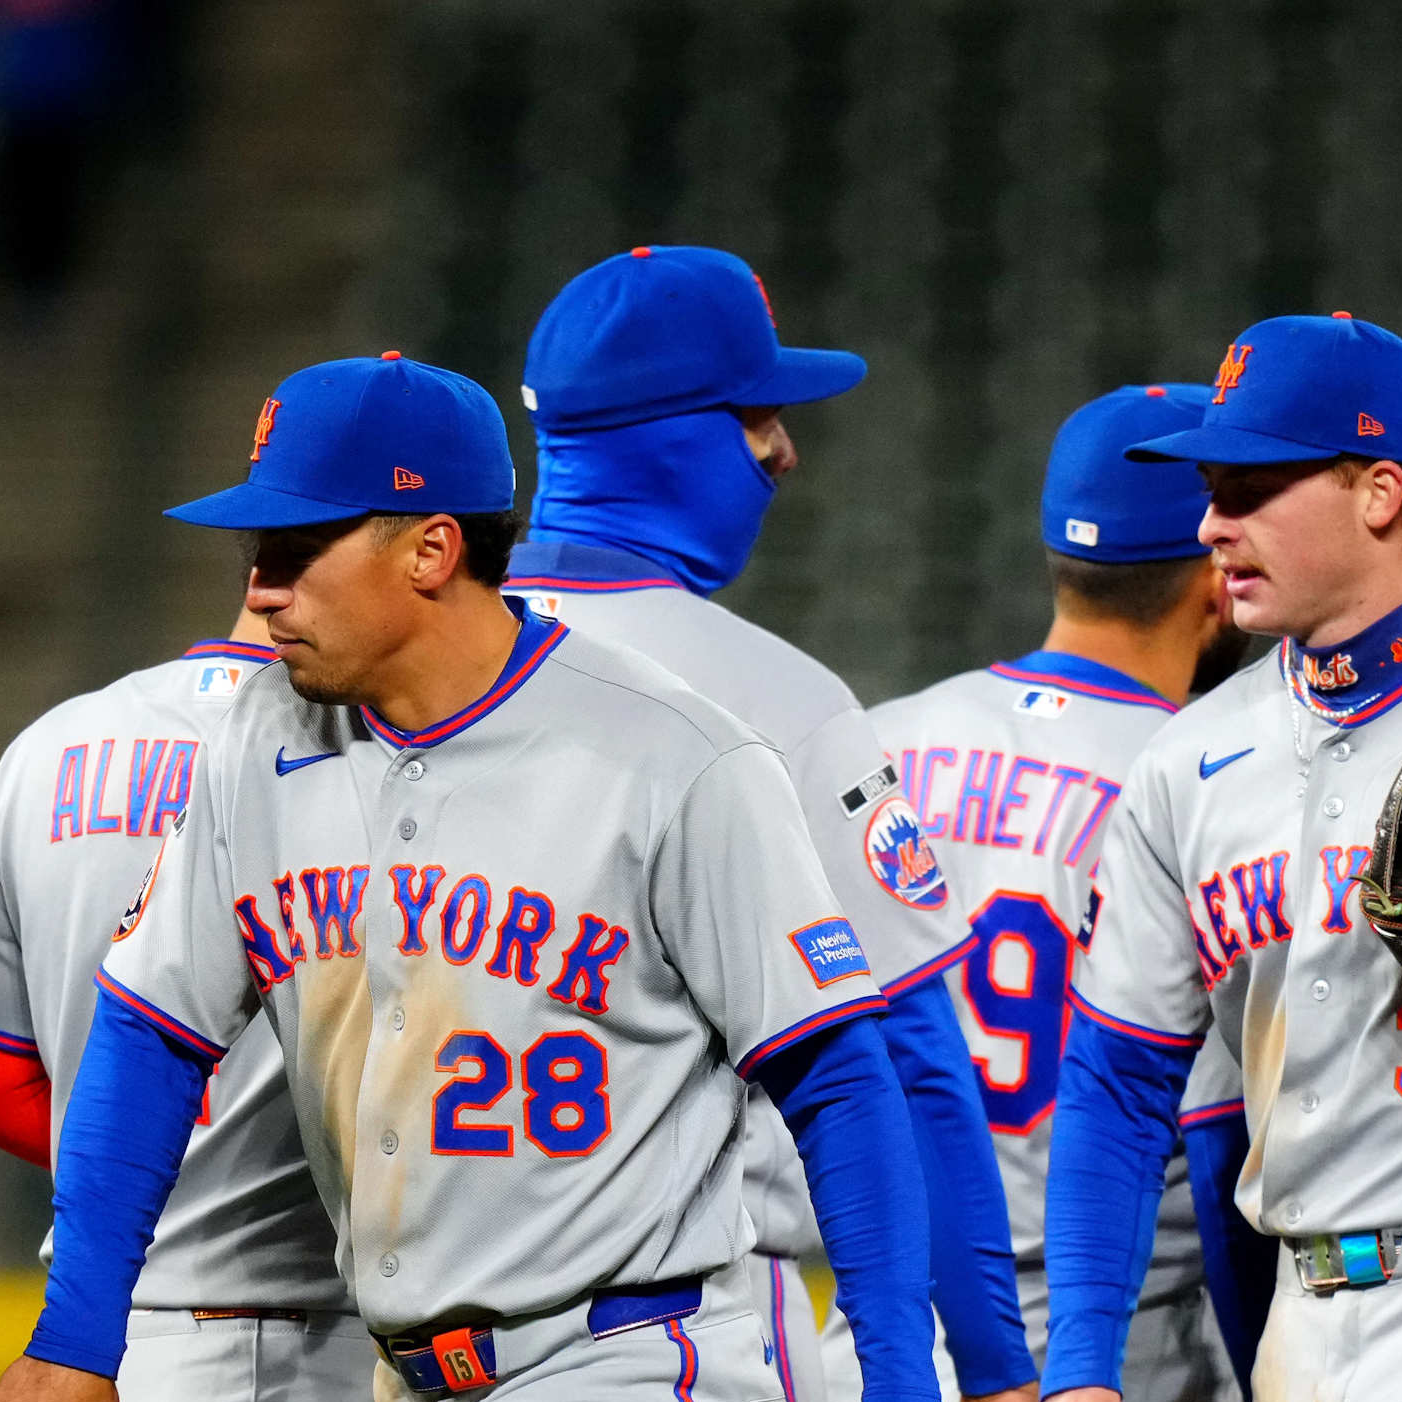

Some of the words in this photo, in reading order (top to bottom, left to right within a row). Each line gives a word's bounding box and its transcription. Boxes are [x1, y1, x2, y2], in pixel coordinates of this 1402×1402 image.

[234, 864, 371, 994] NEW
[388, 863, 631, 1015] YORK
[430, 1028, 613, 1159] 28
[443, 1350, 474, 1382] 15
